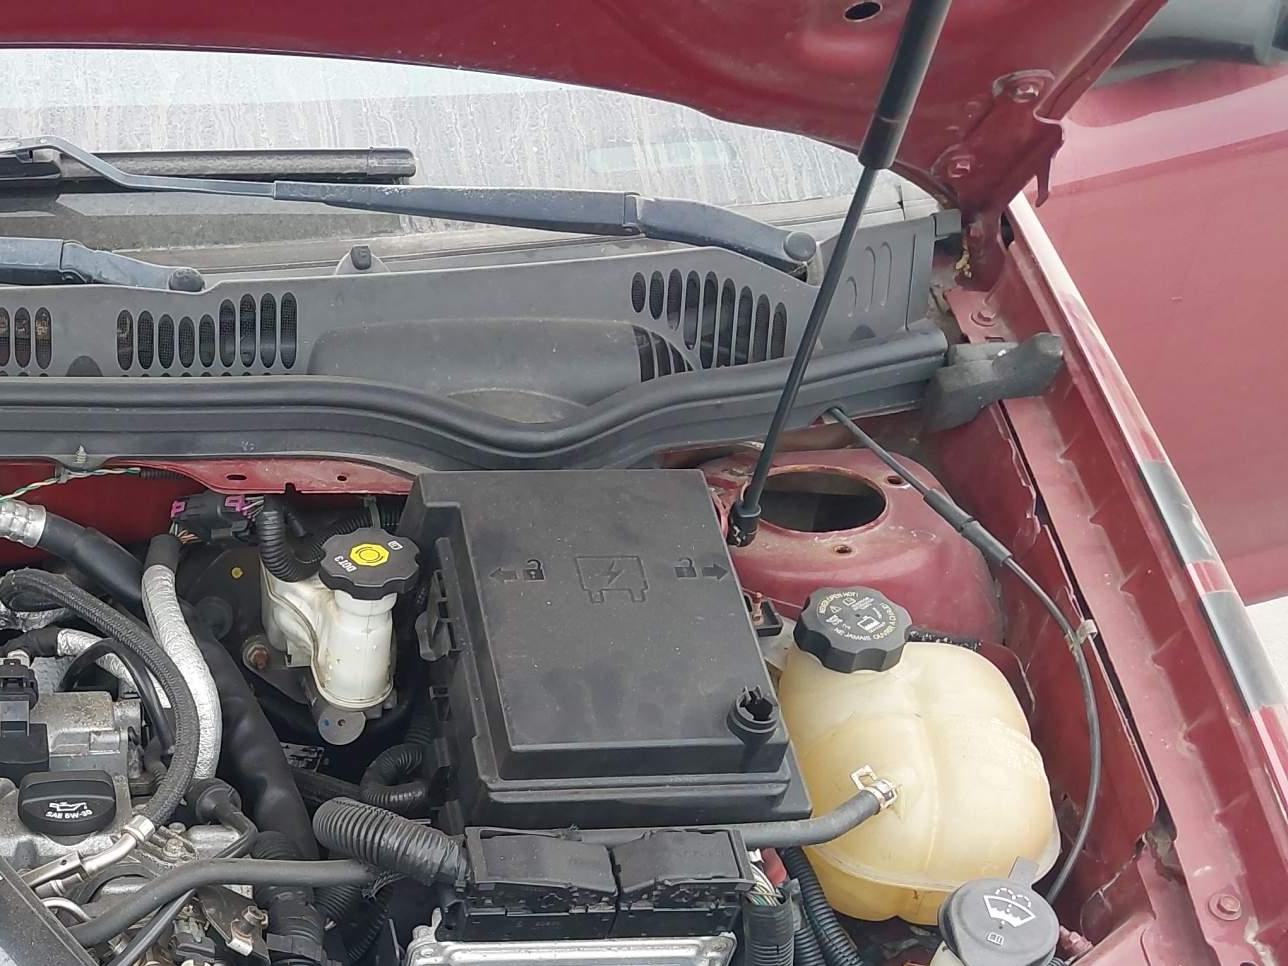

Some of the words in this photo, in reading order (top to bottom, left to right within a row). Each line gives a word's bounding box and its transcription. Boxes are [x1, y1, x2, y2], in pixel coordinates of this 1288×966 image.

[338, 560, 357, 572] DOT
[844, 632, 871, 640] JAMAIS
[46, 811, 63, 819] SAE
[64, 809, 93, 819] 5W-30
